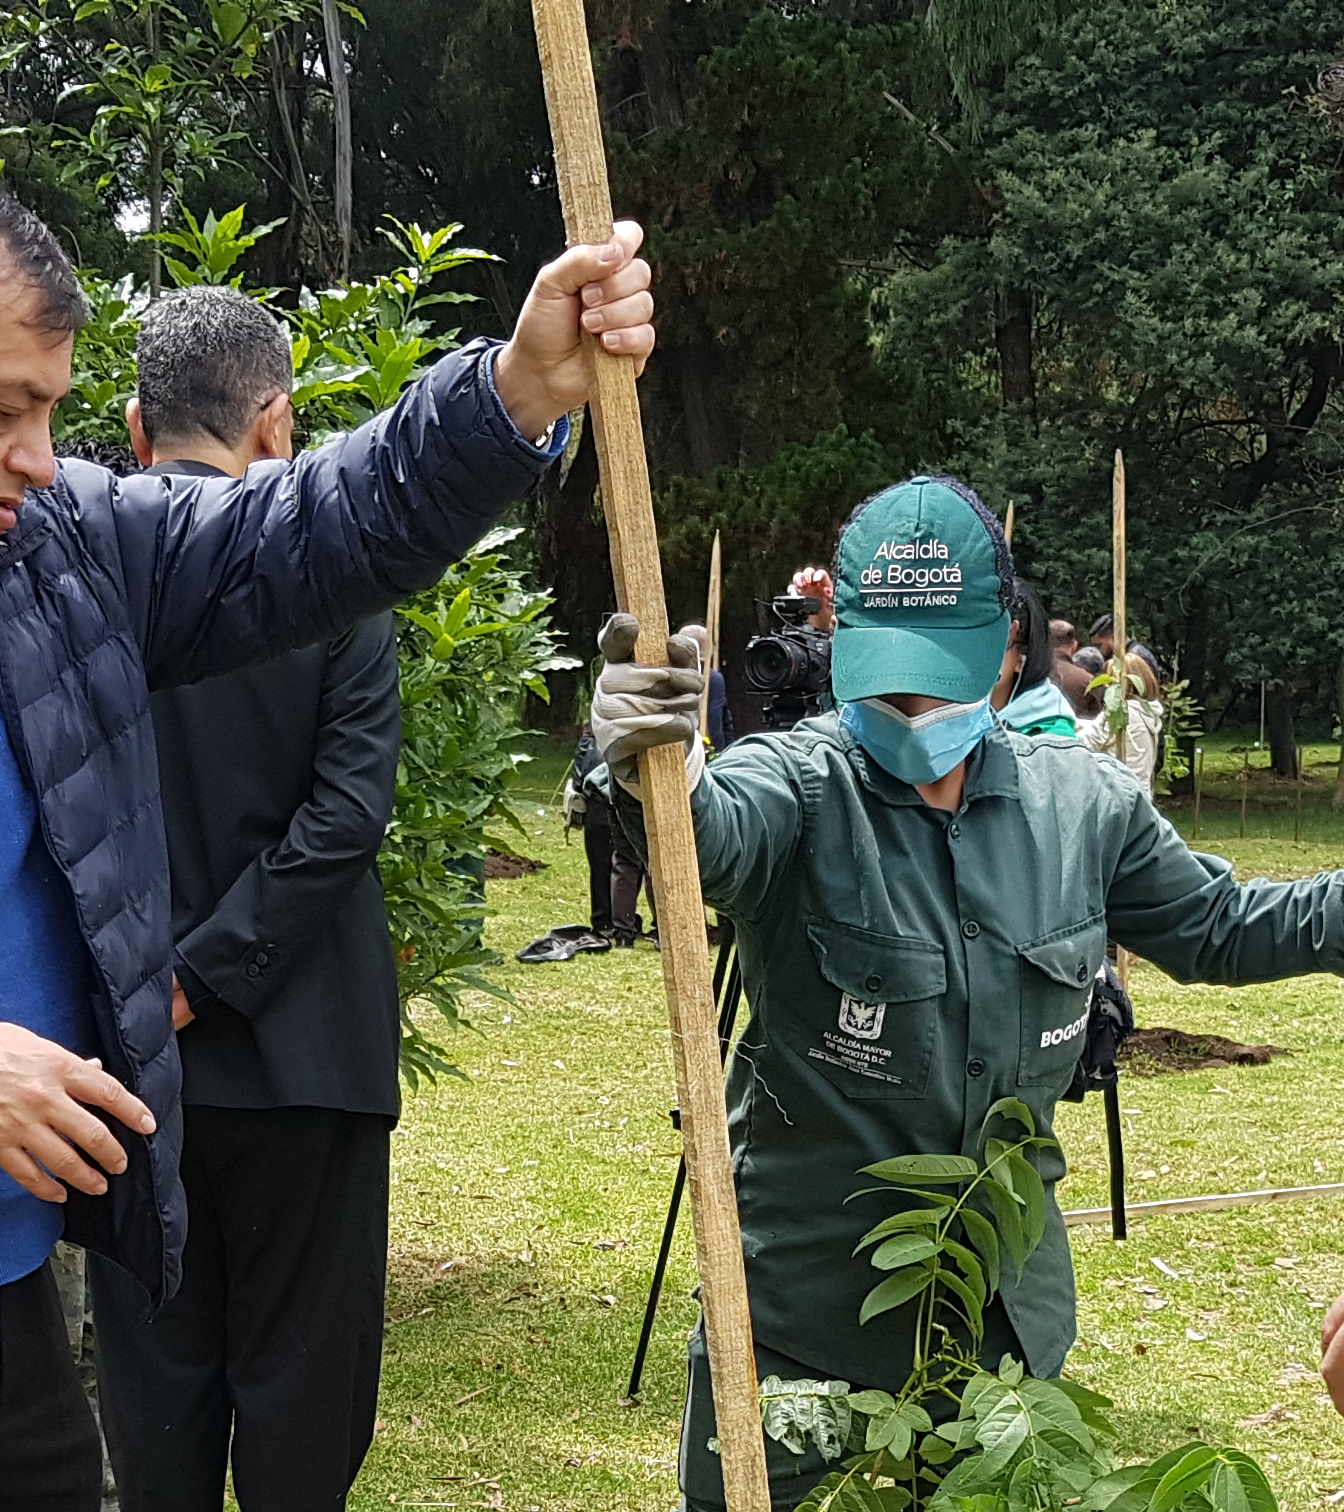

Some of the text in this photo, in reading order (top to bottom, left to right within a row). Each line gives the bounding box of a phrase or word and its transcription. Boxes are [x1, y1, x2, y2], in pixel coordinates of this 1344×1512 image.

[873, 539, 948, 560] Alcaldía
[861, 562, 962, 588] de Bogotá
[864, 592, 957, 608] JARDÍN BOTÁNICO
[822, 1031, 892, 1058] ALCALDÍA MAYOR
[836, 1045, 870, 1062] BOGOTÁ
